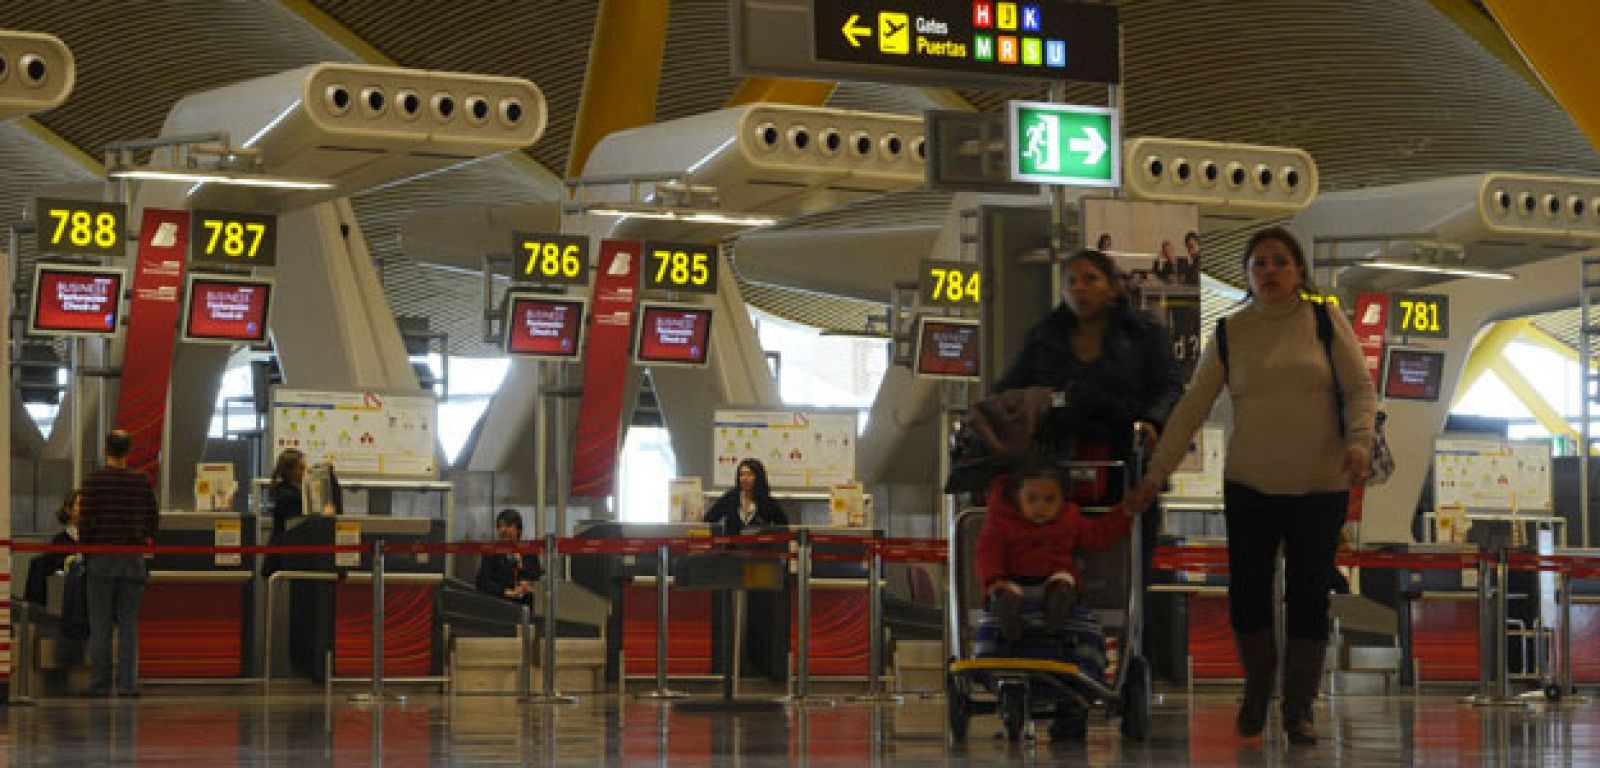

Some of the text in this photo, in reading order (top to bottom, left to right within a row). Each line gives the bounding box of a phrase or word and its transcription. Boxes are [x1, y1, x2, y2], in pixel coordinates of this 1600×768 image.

[916, 17, 948, 33] Gates
[977, 4, 989, 24] H
[1026, 8, 1038, 28] K
[916, 36, 967, 57] Puertas
[977, 37, 1062, 63] M R S U
[48, 209, 116, 249] 788
[204, 219, 265, 257] 787
[523, 242, 580, 278] 786
[653, 250, 708, 285] 785
[931, 268, 981, 303] 784
[1399, 301, 1440, 332] 781
